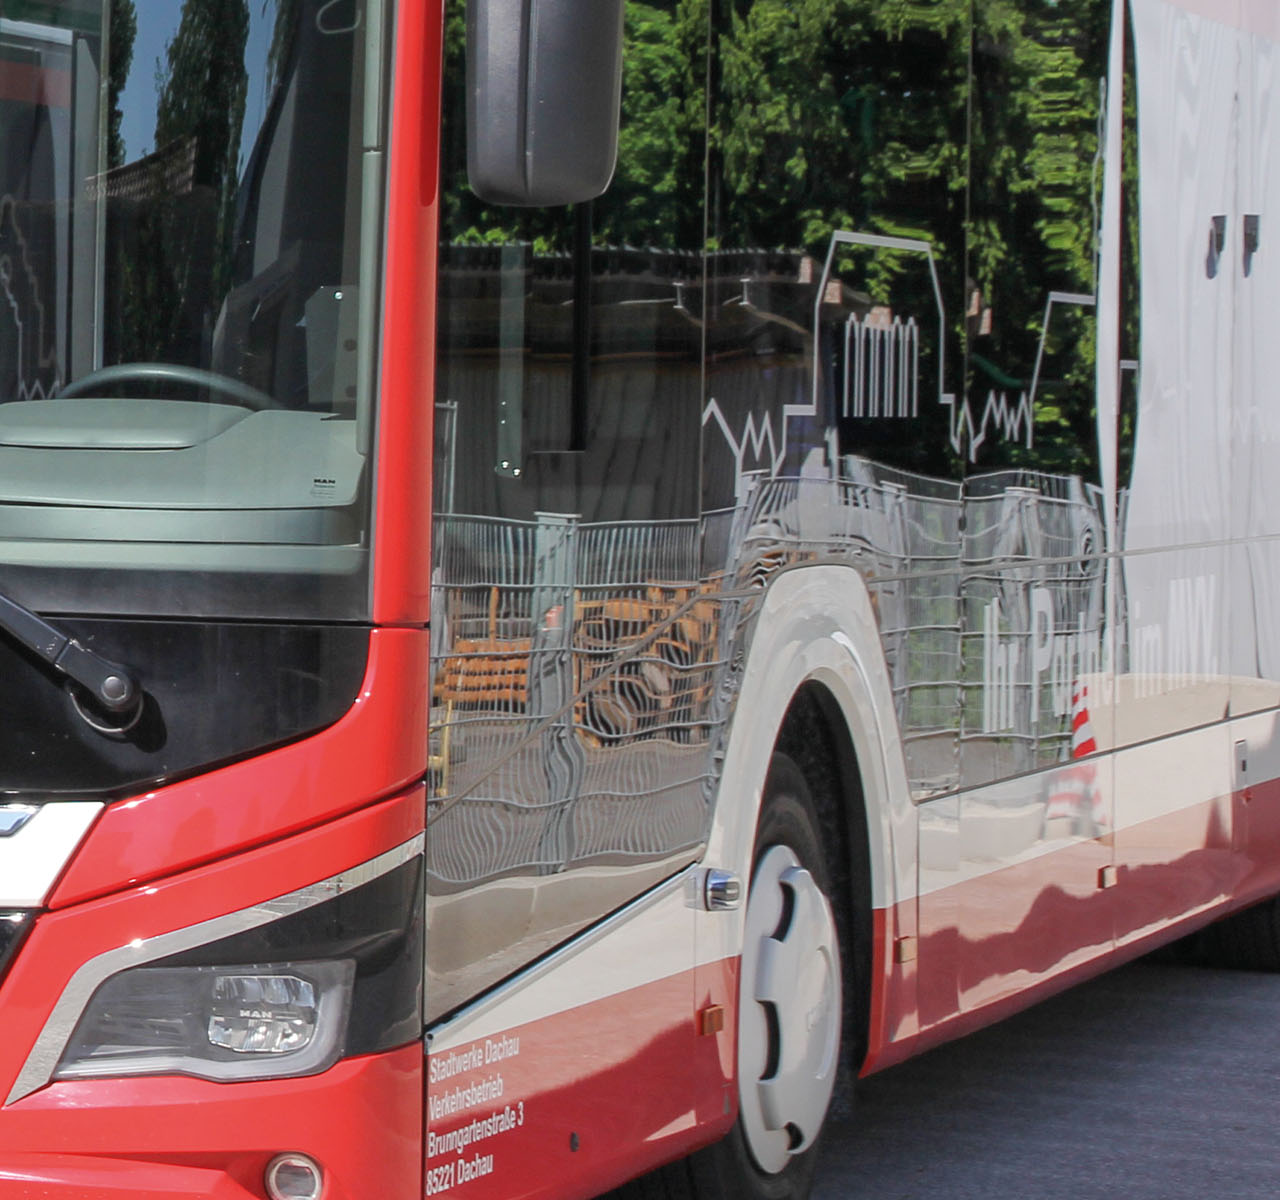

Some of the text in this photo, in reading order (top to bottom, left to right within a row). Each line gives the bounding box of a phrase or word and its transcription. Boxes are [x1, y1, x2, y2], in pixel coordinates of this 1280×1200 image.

[239, 1009, 272, 1018] MAN
[430, 1034, 520, 1084] Stadtwerke Dachau
[429, 1073, 504, 1120] Verkehrsbetrieb
[428, 1101, 524, 1158] Brunngartenstraße 3
[426, 1153, 494, 1196] 85221 Dachau
